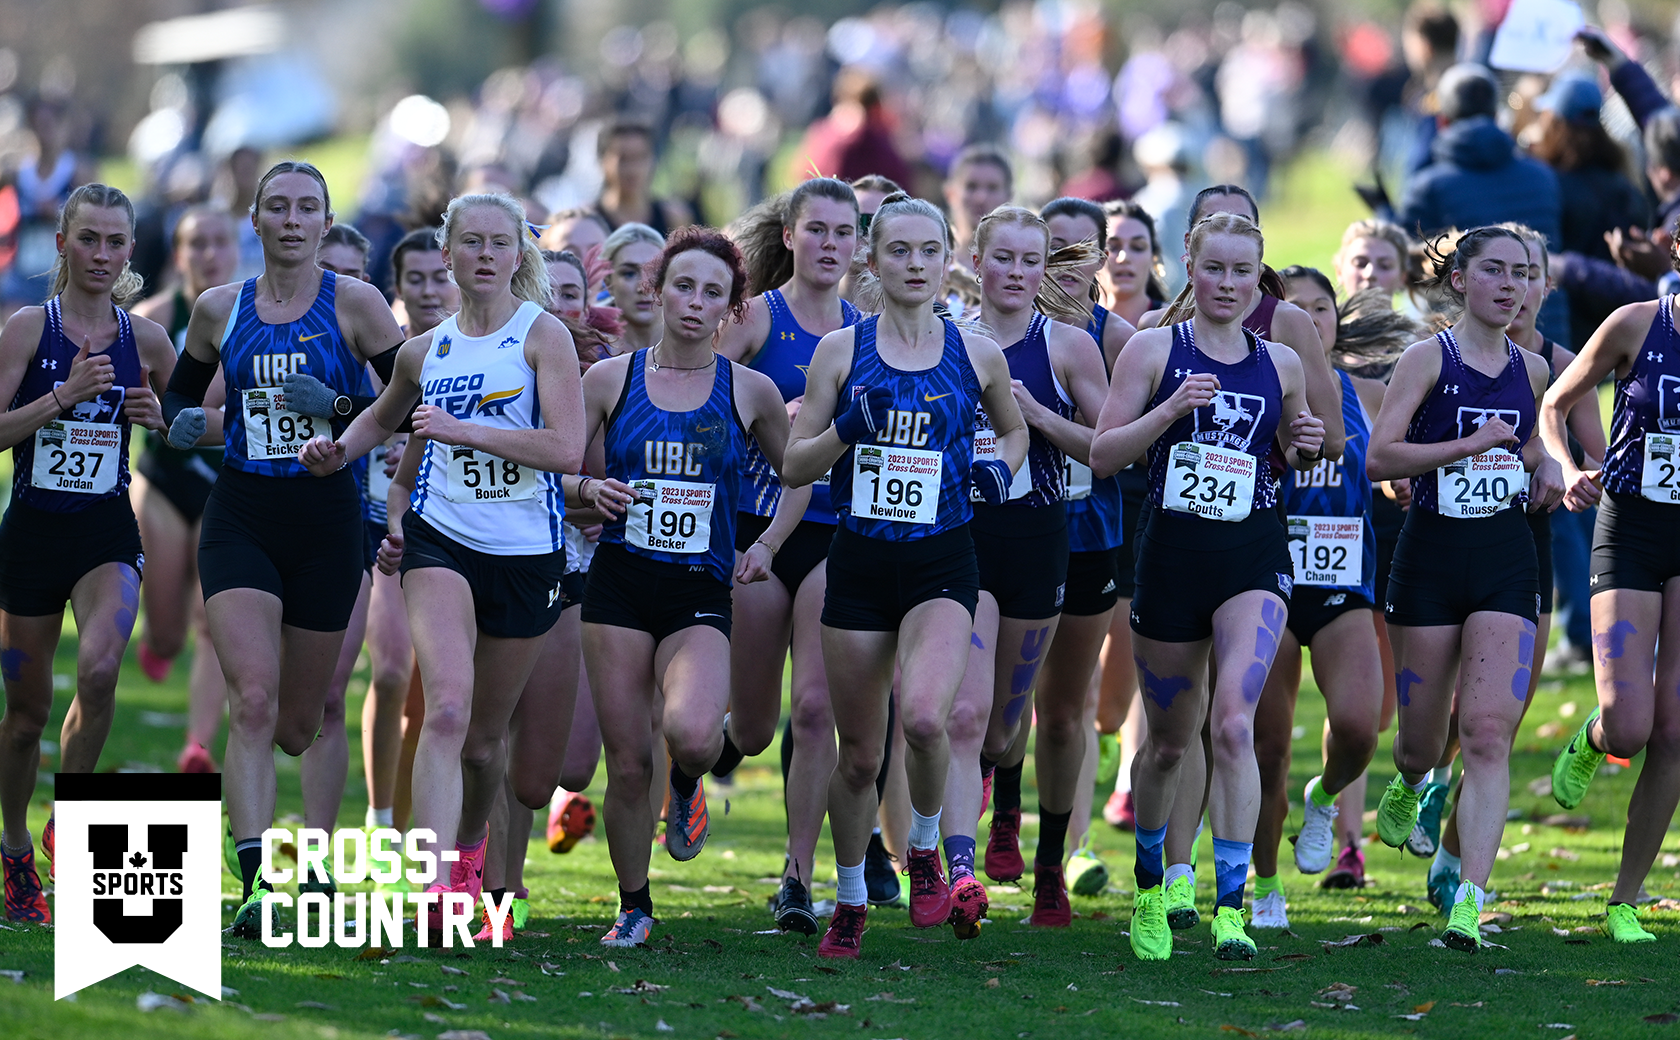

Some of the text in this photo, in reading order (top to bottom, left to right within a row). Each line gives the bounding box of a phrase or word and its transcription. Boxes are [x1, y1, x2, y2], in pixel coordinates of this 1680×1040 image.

[253, 352, 307, 388] UBC
[424, 373, 485, 397] UBCO
[70, 428, 88, 437] 2023
[89, 429, 94, 437] U
[94, 430, 118, 439] SPORTS
[261, 415, 315, 443] 193
[70, 437, 119, 448] Cross Country
[974, 437, 991, 446] 2023
[1196, 431, 1247, 448] MUSTANGS
[266, 444, 303, 455] Ericks
[976, 446, 995, 455] Cross
[48, 450, 104, 478] 237
[644, 440, 704, 476] UBC
[887, 454, 906, 464] 2023
[906, 456, 912, 464] U
[912, 456, 938, 467] SPORTS
[1205, 452, 1223, 463] 2023
[1223, 456, 1229, 464] U
[1229, 456, 1253, 469] SPORTS
[1471, 454, 1488, 462] 2023
[463, 459, 521, 488] 518
[887, 463, 938, 477] Cross Country
[1204, 460, 1253, 478] Cross Country
[1471, 463, 1492, 471] Cross
[1492, 463, 1520, 472] Country
[56, 476, 93, 489] Jordan
[1179, 472, 1237, 507] 234
[475, 486, 510, 500] Bouck
[661, 487, 680, 496] 2023
[680, 488, 686, 497] U
[686, 489, 712, 499] SPORTS
[870, 476, 923, 507] 196
[1454, 477, 1509, 503] 240
[661, 496, 711, 508] Cross Country
[1187, 501, 1224, 517] Coutts
[870, 504, 917, 519] Newlove
[644, 509, 696, 538] 190
[1314, 523, 1330, 531] 2023
[1336, 523, 1359, 532] SPORTS
[648, 535, 686, 549] Becker
[1314, 531, 1359, 541] Cross Country
[1298, 545, 1347, 570] 192
[1305, 570, 1337, 584] Chang
